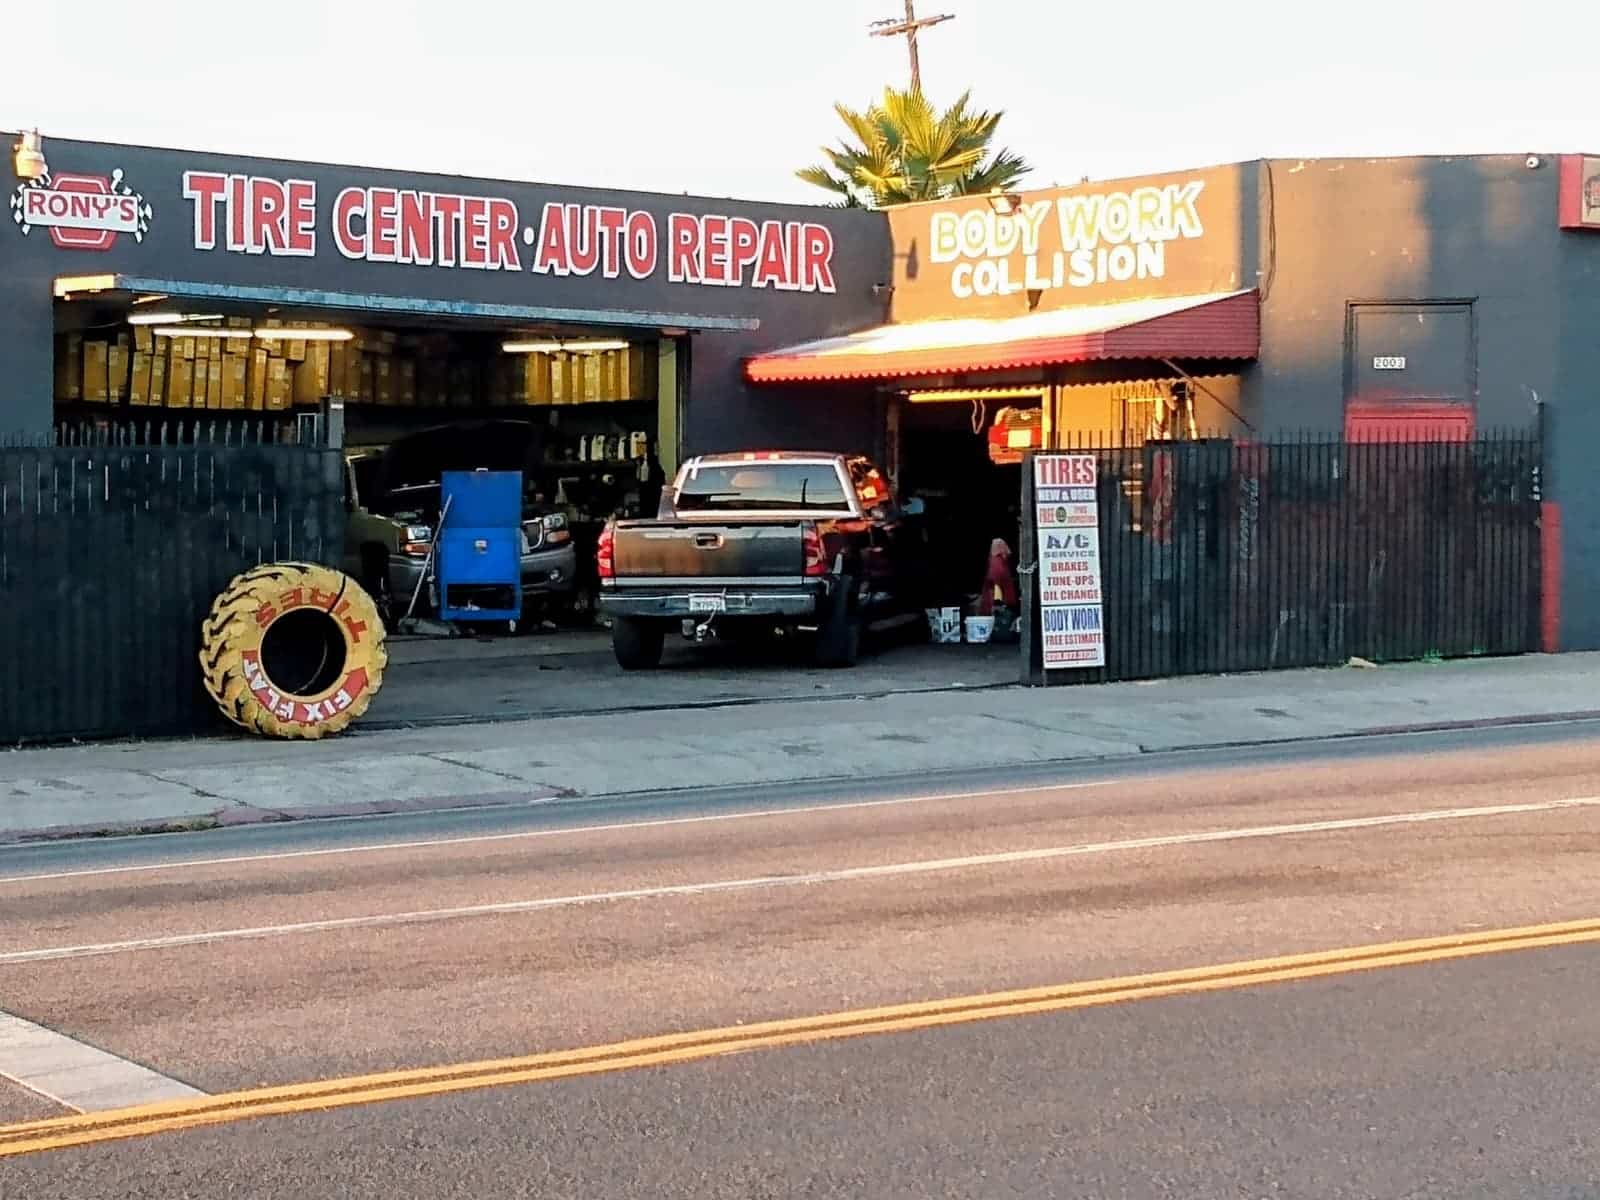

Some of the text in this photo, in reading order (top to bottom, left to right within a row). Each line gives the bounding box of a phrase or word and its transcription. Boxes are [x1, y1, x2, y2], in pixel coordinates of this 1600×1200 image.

[28, 191, 136, 222] RONY'S
[183, 171, 836, 294] TIRE CENTER AUTO REPAIR
[929, 181, 1205, 263] BODY WORK
[951, 240, 1165, 298] COLLISION
[1037, 458, 1094, 485] TIRES
[1043, 550, 1096, 559] SERVICE
[1046, 533, 1090, 549] A/C
[1051, 561, 1089, 572] BRAKES
[1046, 575, 1095, 586] TUNE-UPS
[1043, 589, 1099, 601] OIL CHANGE
[256, 587, 368, 643] TIRES
[1044, 607, 1100, 632] BODY WORK
[243, 659, 353, 722] FIX FLAT
